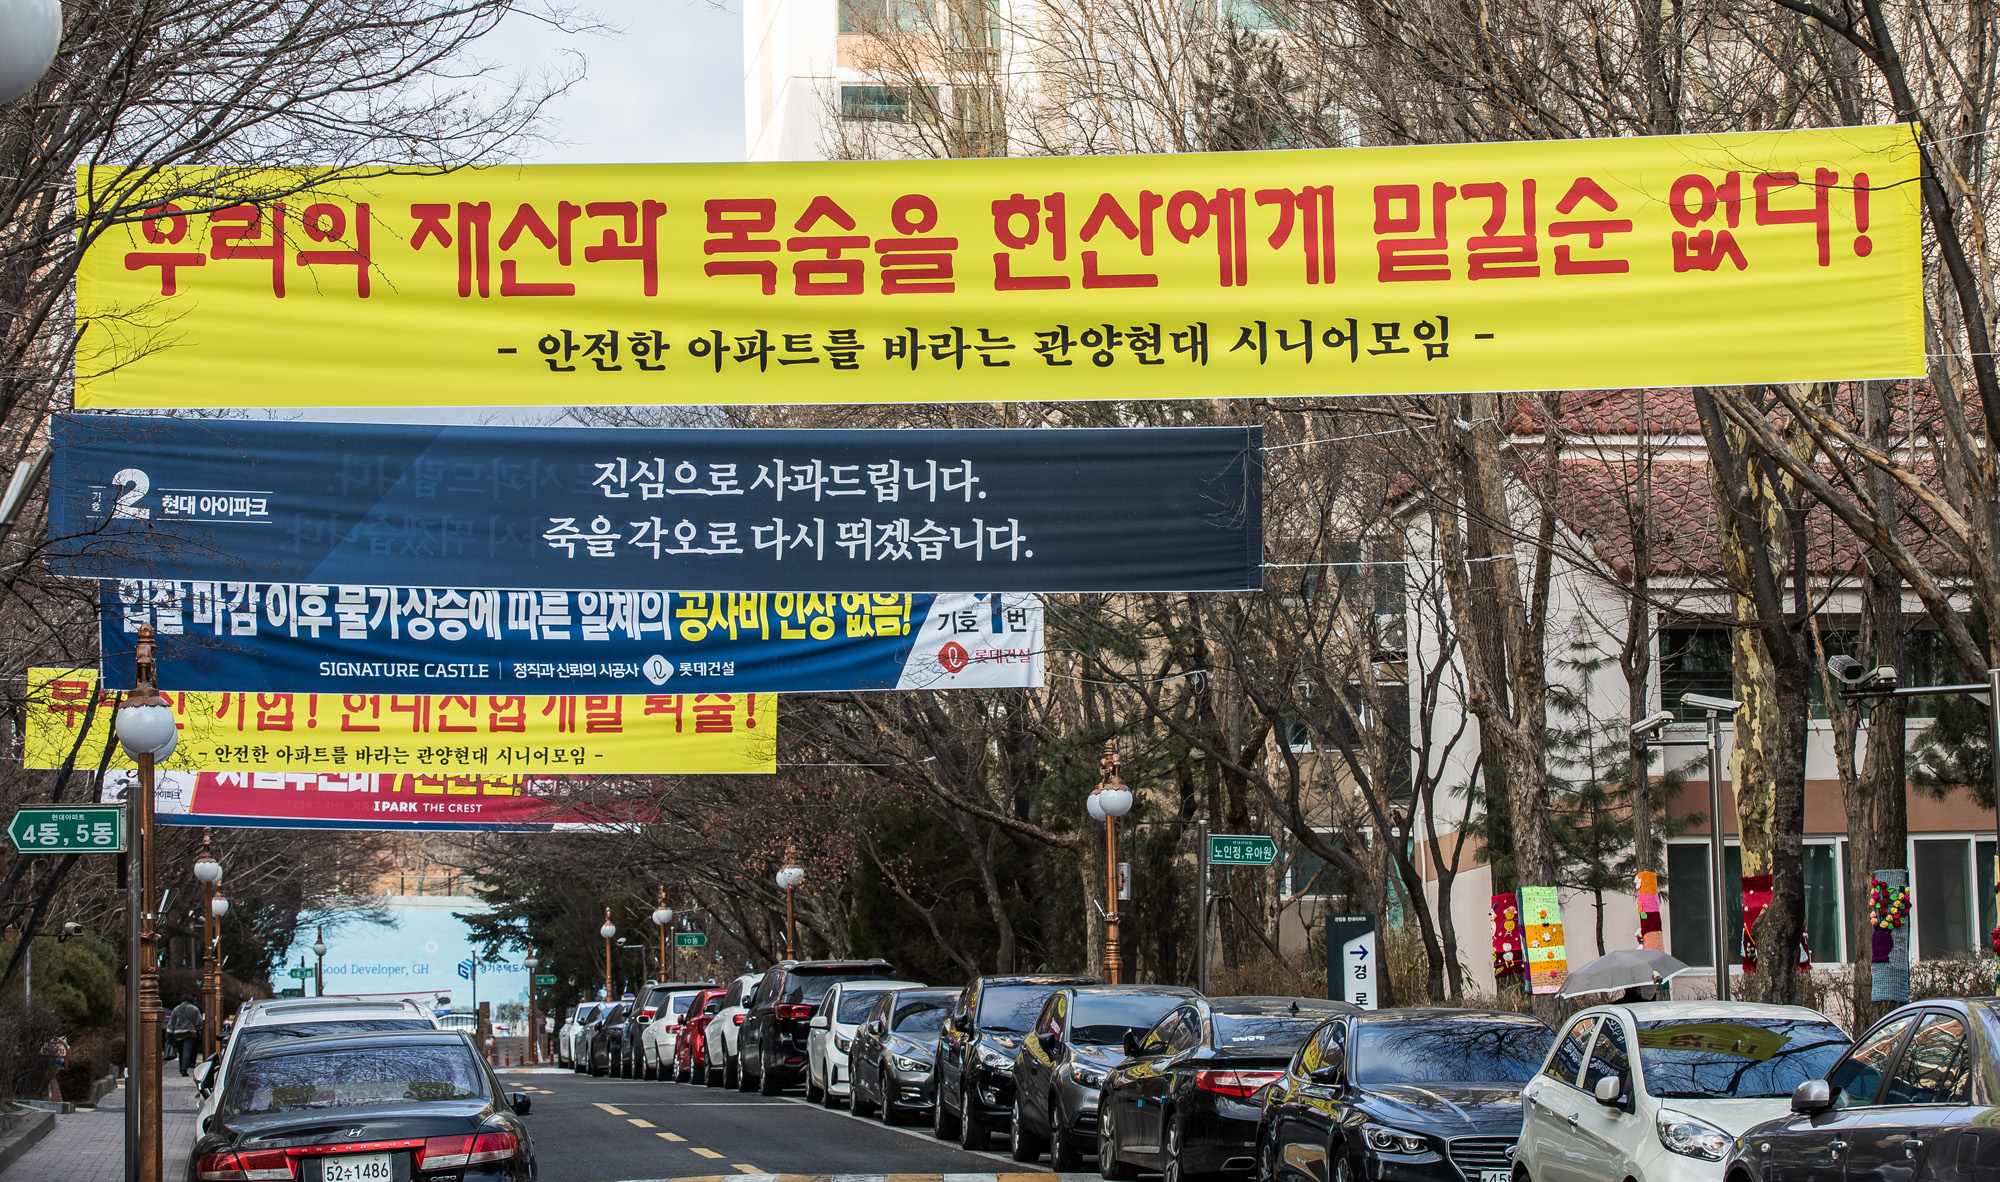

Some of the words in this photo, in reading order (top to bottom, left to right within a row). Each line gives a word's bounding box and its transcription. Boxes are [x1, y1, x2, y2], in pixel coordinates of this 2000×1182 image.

[124, 201, 371, 298] 우리의
[410, 200, 667, 297] 재산과
[703, 193, 959, 296] 목숨을
[991, 185, 1335, 291] 현산에게
[1373, 177, 1633, 283] 맡길순
[1670, 167, 1873, 273] 없다!
[538, 329, 670, 372] 안전한
[688, 329, 864, 373] 아파트를
[883, 326, 1016, 371] 바라는
[1033, 322, 1209, 367] 관양현대
[1229, 315, 1449, 365] 시니어모임
[592, 457, 744, 500] 진심으로
[750, 458, 987, 502] 사과드립니다.
[112, 468, 150, 519] 2
[162, 494, 196, 515] 현대
[199, 496, 269, 517] 아이파크
[543, 515, 622, 558] 죽을
[628, 516, 744, 560] 각오로
[750, 517, 824, 561] 다시
[835, 517, 1034, 561] 뛰겠습니다.
[193, 582, 260, 636] 마감
[508, 591, 572, 640] 따른
[577, 592, 671, 641] 일체의
[676, 593, 770, 641] 공사비
[775, 593, 836, 640] 인상
[841, 593, 913, 638] 없음!
[937, 611, 979, 634] 기호
[1007, 607, 1027, 632] 번
[975, 648, 1031, 664] 롯데건설
[319, 662, 419, 677] SIGNATURE
[424, 663, 489, 678] CASTLE
[513, 663, 555, 679] 정직과
[556, 663, 597, 678] 신뢰의
[600, 662, 639, 678] 시공사
[679, 661, 735, 677] 롯데건설
[215, 745, 269, 763] 안전한
[276, 746, 348, 764] 아파트를
[356, 746, 409, 765] 바라는
[416, 747, 488, 765] 관양현대
[496, 747, 585, 765] 시니어모임
[373, 801, 418, 812] IPARK
[423, 803, 445, 812] THE
[448, 804, 483, 813] CREST
[22, 823, 69, 845] 4동,
[76, 823, 113, 845] 5동
[320, 963, 347, 975] Good
[351, 964, 409, 976] Developer,
[412, 964, 429, 974] GH
[326, 1162, 389, 1182] 52수1486
